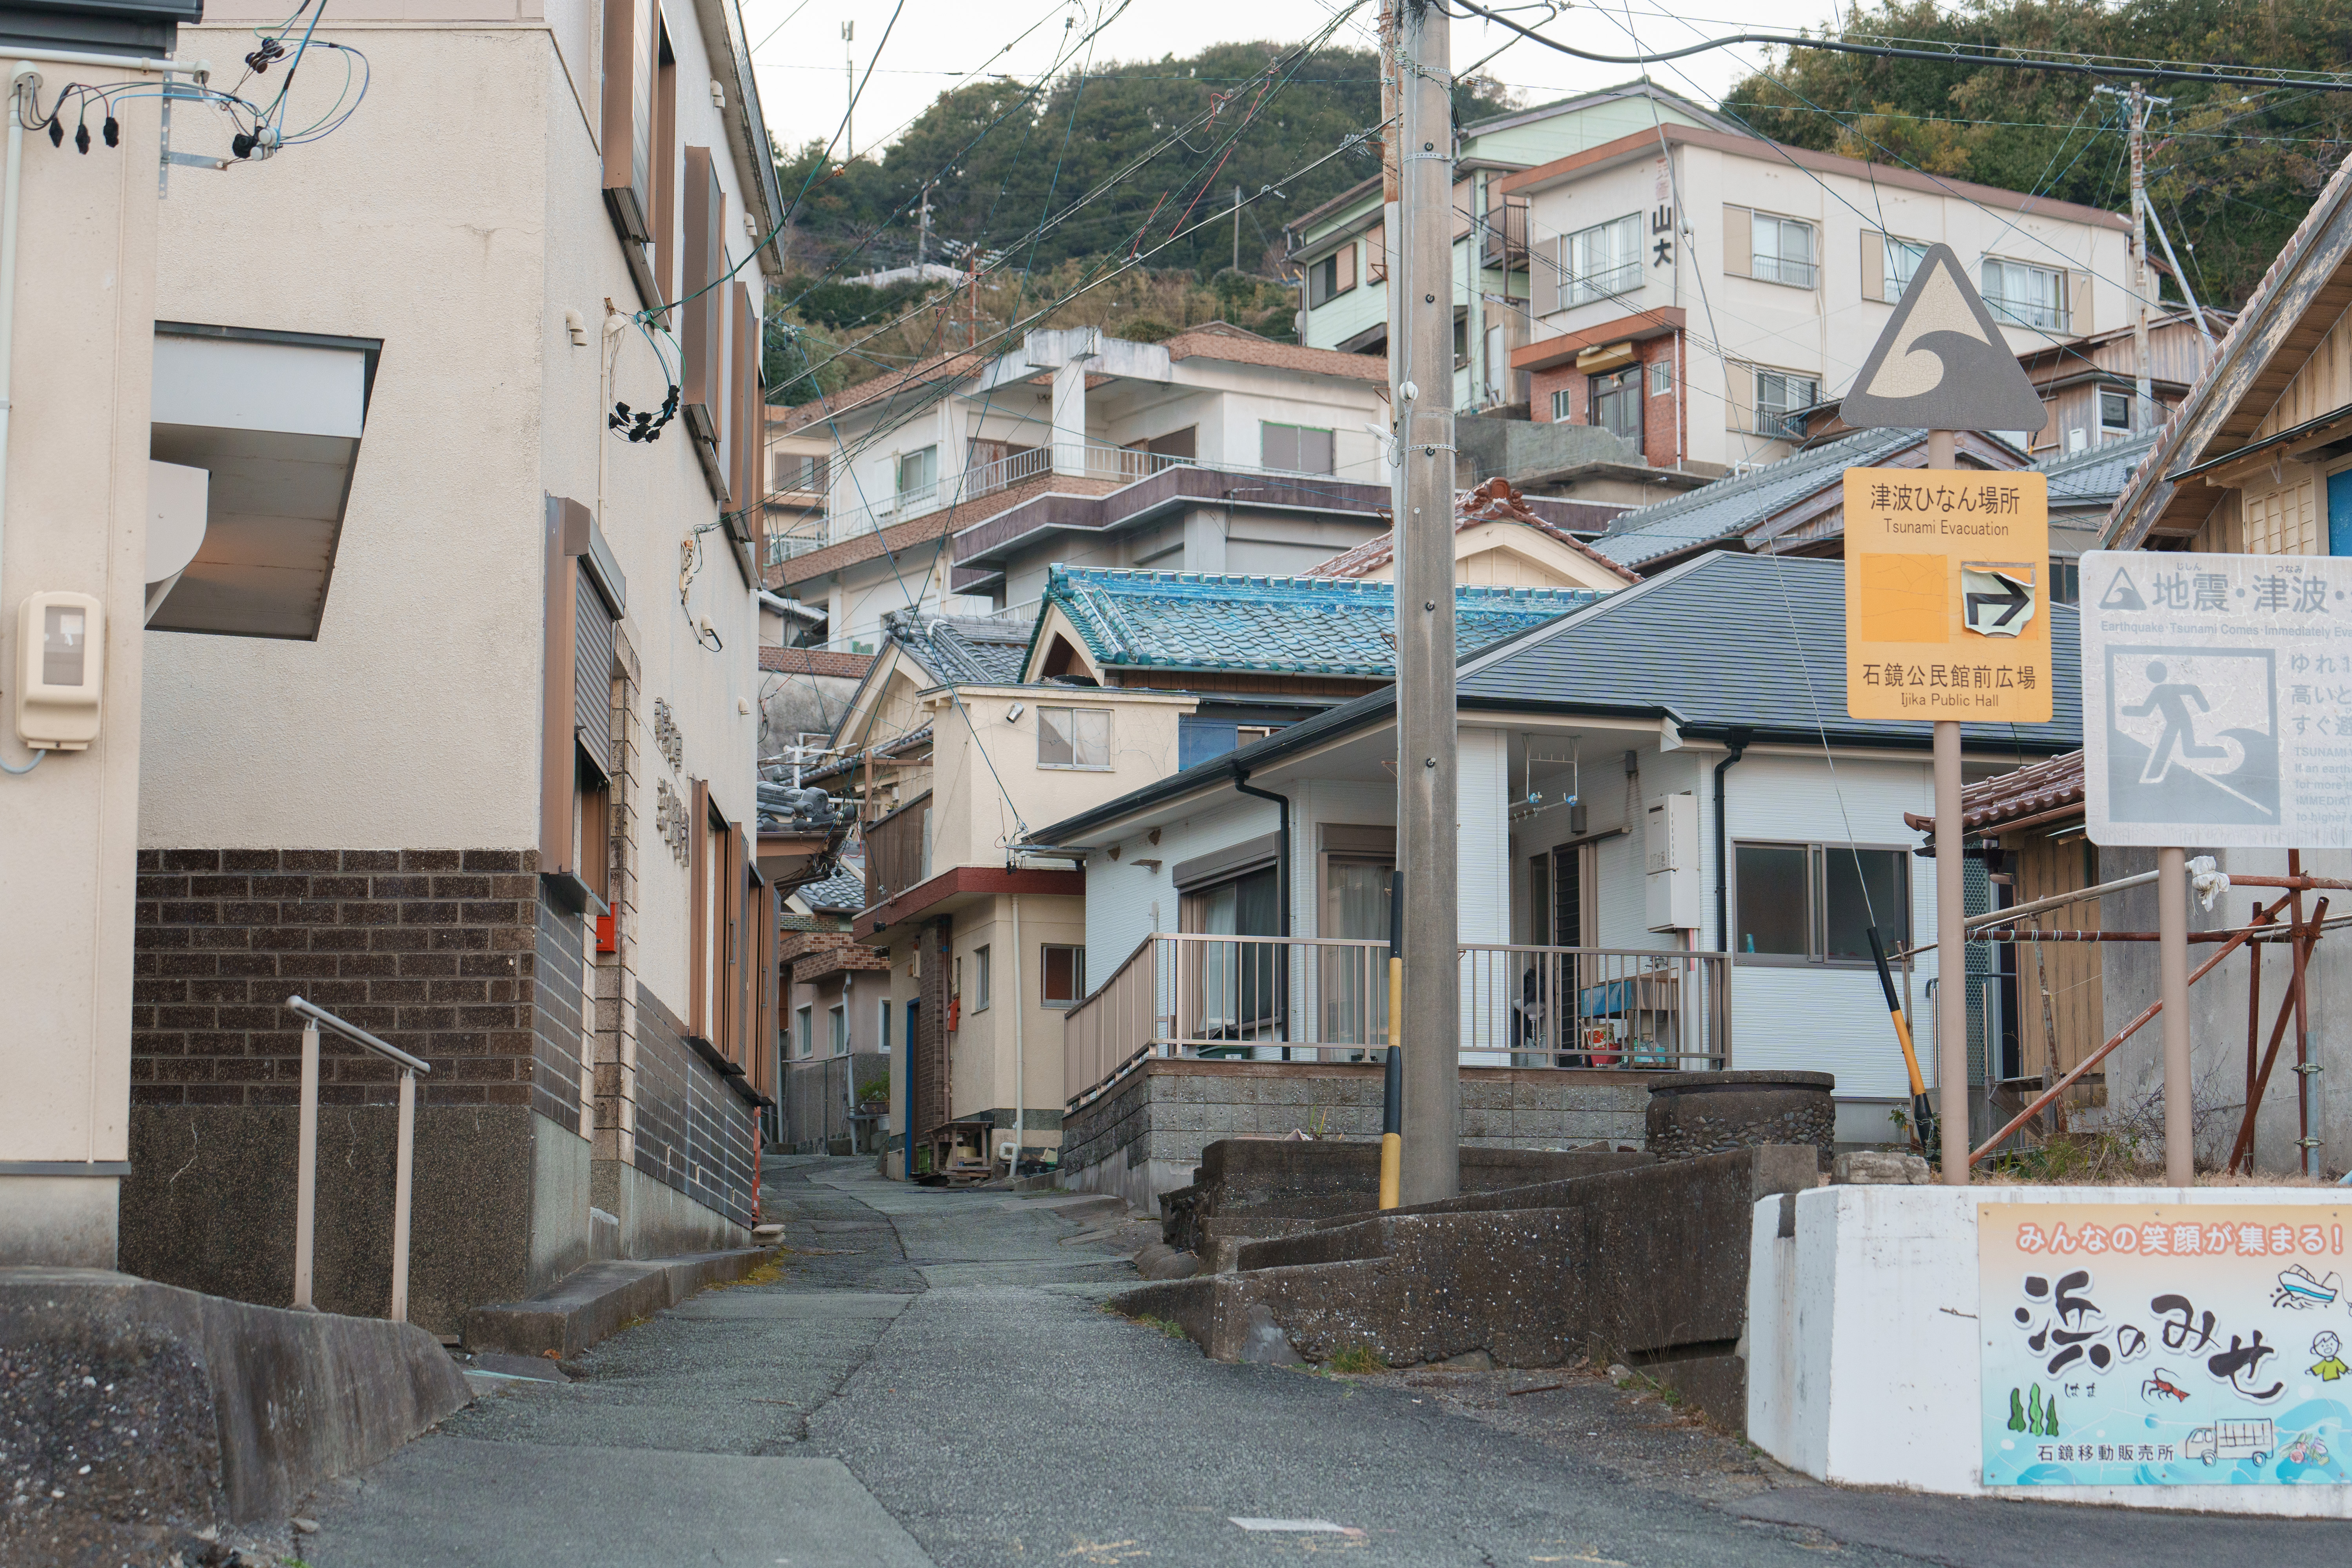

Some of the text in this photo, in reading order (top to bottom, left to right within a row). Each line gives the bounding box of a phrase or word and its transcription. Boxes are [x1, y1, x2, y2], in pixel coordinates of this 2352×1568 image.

[1871, 483, 2020, 515] 津波ひなん場所
[1884, 518, 2009, 536] Tsunami Evacuation
[2176, 562, 2202, 571] じしん
[2276, 565, 2303, 573] つなみ
[2152, 572, 2352, 614] 地震・津波・
[1862, 662, 2036, 690] 石鏡公民館前広場
[1901, 693, 1999, 707] Ijika Public Hall
[2322, 764, 2352, 773] earth
[2297, 813, 2307, 821] to
[2311, 812, 2347, 824] higher
[2017, 1221, 2343, 1257] みんなの笑顔が集まる!
[2014, 1269, 2285, 1399] 浜のみせ
[2064, 1381, 2097, 1398] はま
[2036, 1444, 2175, 1463] 石鏡移動販売所
